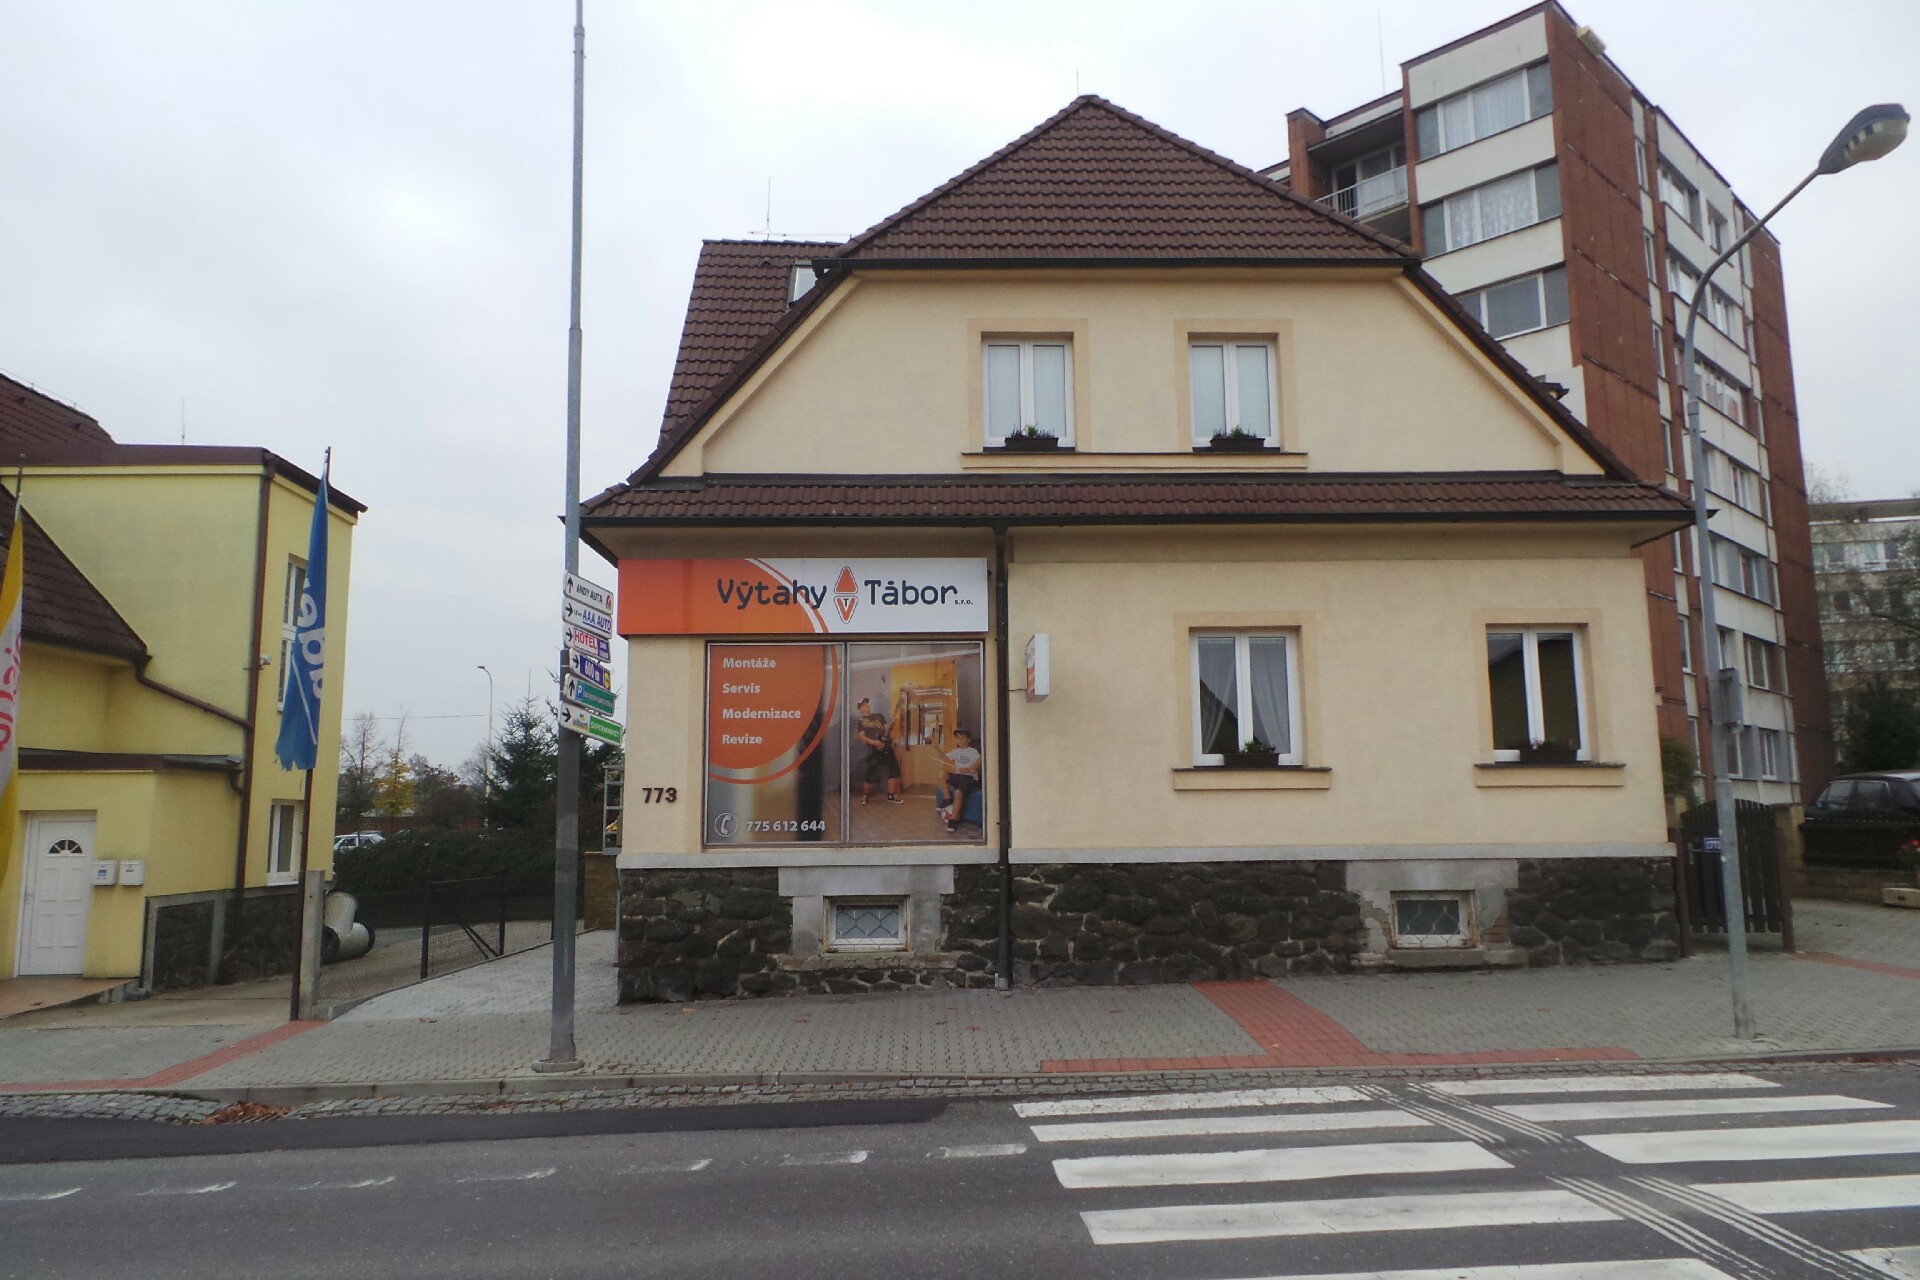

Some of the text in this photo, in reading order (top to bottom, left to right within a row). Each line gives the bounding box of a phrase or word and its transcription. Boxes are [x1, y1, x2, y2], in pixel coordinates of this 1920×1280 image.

[576, 584, 590, 597] ANDY
[717, 579, 827, 610] Výtahy
[864, 580, 958, 605] Tábor
[583, 609, 596, 625] AAA
[596, 616, 612, 631] AUTO
[575, 630, 597, 649] HOTEL
[723, 657, 776, 668] Montáže
[585, 660, 595, 679] 600
[577, 684, 583, 696] P
[722, 682, 761, 694] Servis
[722, 708, 801, 719] Modernizace
[590, 721, 620, 737] SUPERMARKET
[722, 733, 763, 744] Revize
[642, 787, 678, 804] 773
[746, 820, 826, 832] 775 612 644
